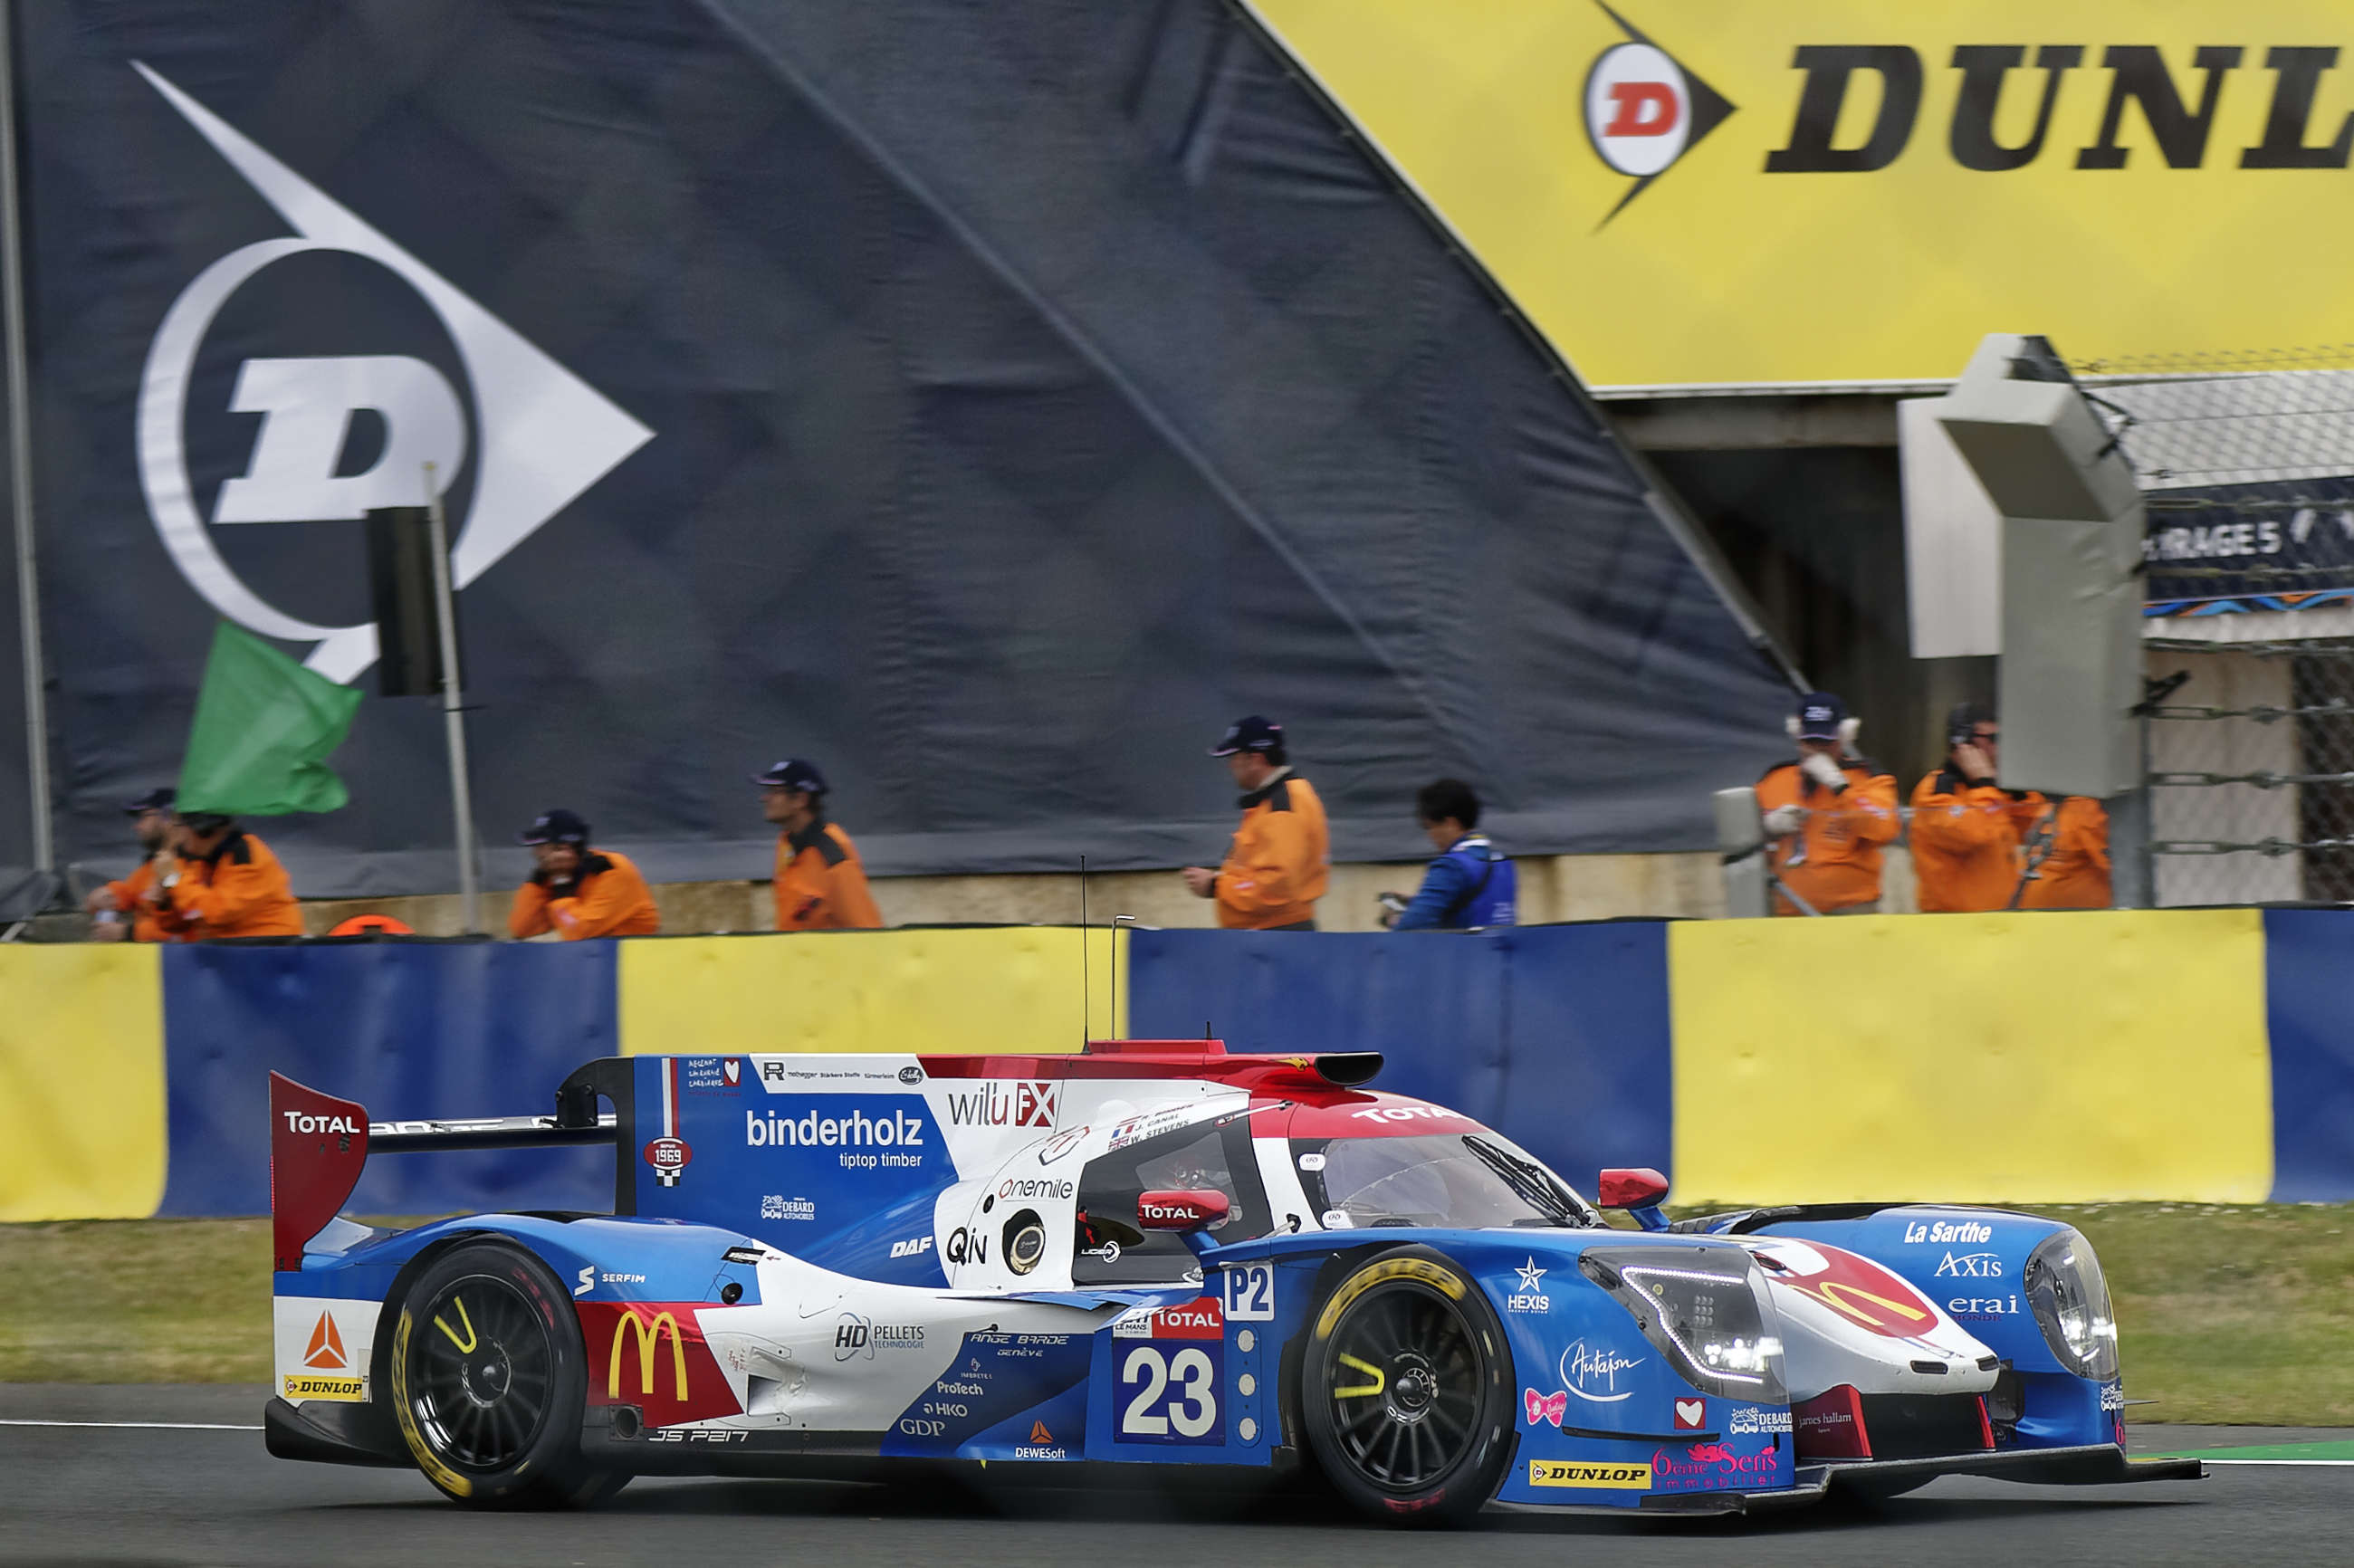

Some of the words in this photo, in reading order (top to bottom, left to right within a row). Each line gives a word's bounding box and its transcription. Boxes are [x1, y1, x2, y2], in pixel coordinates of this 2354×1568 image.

[283, 1111, 361, 1133] TOTAL
[746, 1110, 923, 1146] binderholz
[655, 1149, 682, 1163] 1969
[839, 1152, 877, 1170] tiptop
[880, 1152, 923, 1167] timber
[782, 1201, 815, 1213] DEBARD
[1141, 1204, 1200, 1219] TOTAL
[1904, 1221, 1928, 1243] La
[1929, 1221, 1992, 1243] Sarthe
[889, 1235, 933, 1258] DAF
[1933, 1250, 2003, 1277] Axis
[601, 1273, 646, 1283] SERFIM
[1230, 1267, 1269, 1312] P2
[1507, 1294, 1550, 1310] HEXIS
[1947, 1295, 2020, 1315] erai
[1157, 1311, 1220, 1327] TOTAL
[835, 1324, 868, 1348] HD
[874, 1324, 924, 1340] PELLETS
[874, 1340, 924, 1349] TECHNOLOGIE
[1571, 1343, 1647, 1392] Autajon
[299, 1382, 362, 1394] DUNLOP
[936, 1381, 984, 1396] ProTech
[1122, 1346, 1217, 1438] 23
[935, 1402, 969, 1418] HKO
[1823, 1412, 1852, 1424] hallam
[648, 1430, 684, 1442] JS
[690, 1430, 749, 1442] P217
[900, 1419, 946, 1437] GDP
[1015, 1447, 1066, 1459] DEWESoft
[1717, 1442, 1777, 1475] Sens
[1549, 1468, 1646, 1481] DUNLOP
[1656, 1476, 1775, 1489] immobilier
